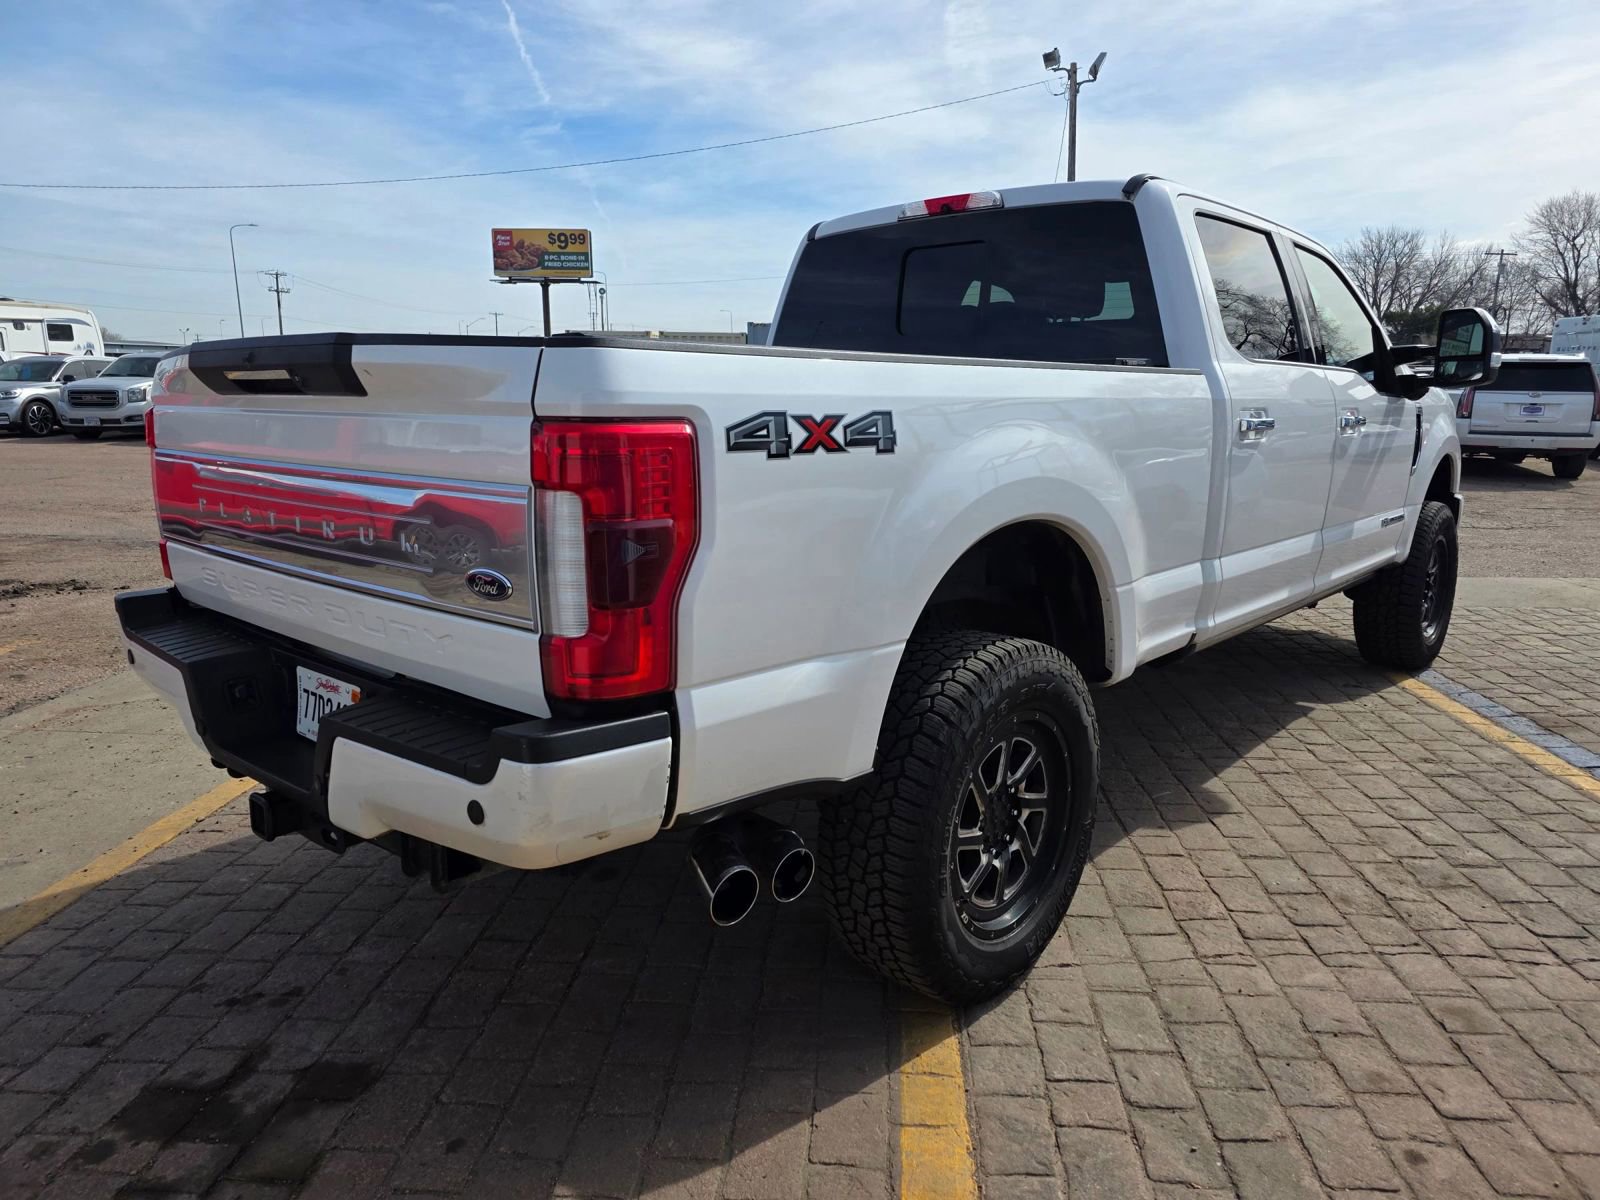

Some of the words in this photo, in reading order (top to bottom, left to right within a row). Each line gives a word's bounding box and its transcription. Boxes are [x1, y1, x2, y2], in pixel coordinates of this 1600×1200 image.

[199, 497, 420, 553] PLATINUM
[201, 566, 314, 616] SUPER
[322, 600, 455, 656] DUTY
[473, 574, 499, 595] Ford
